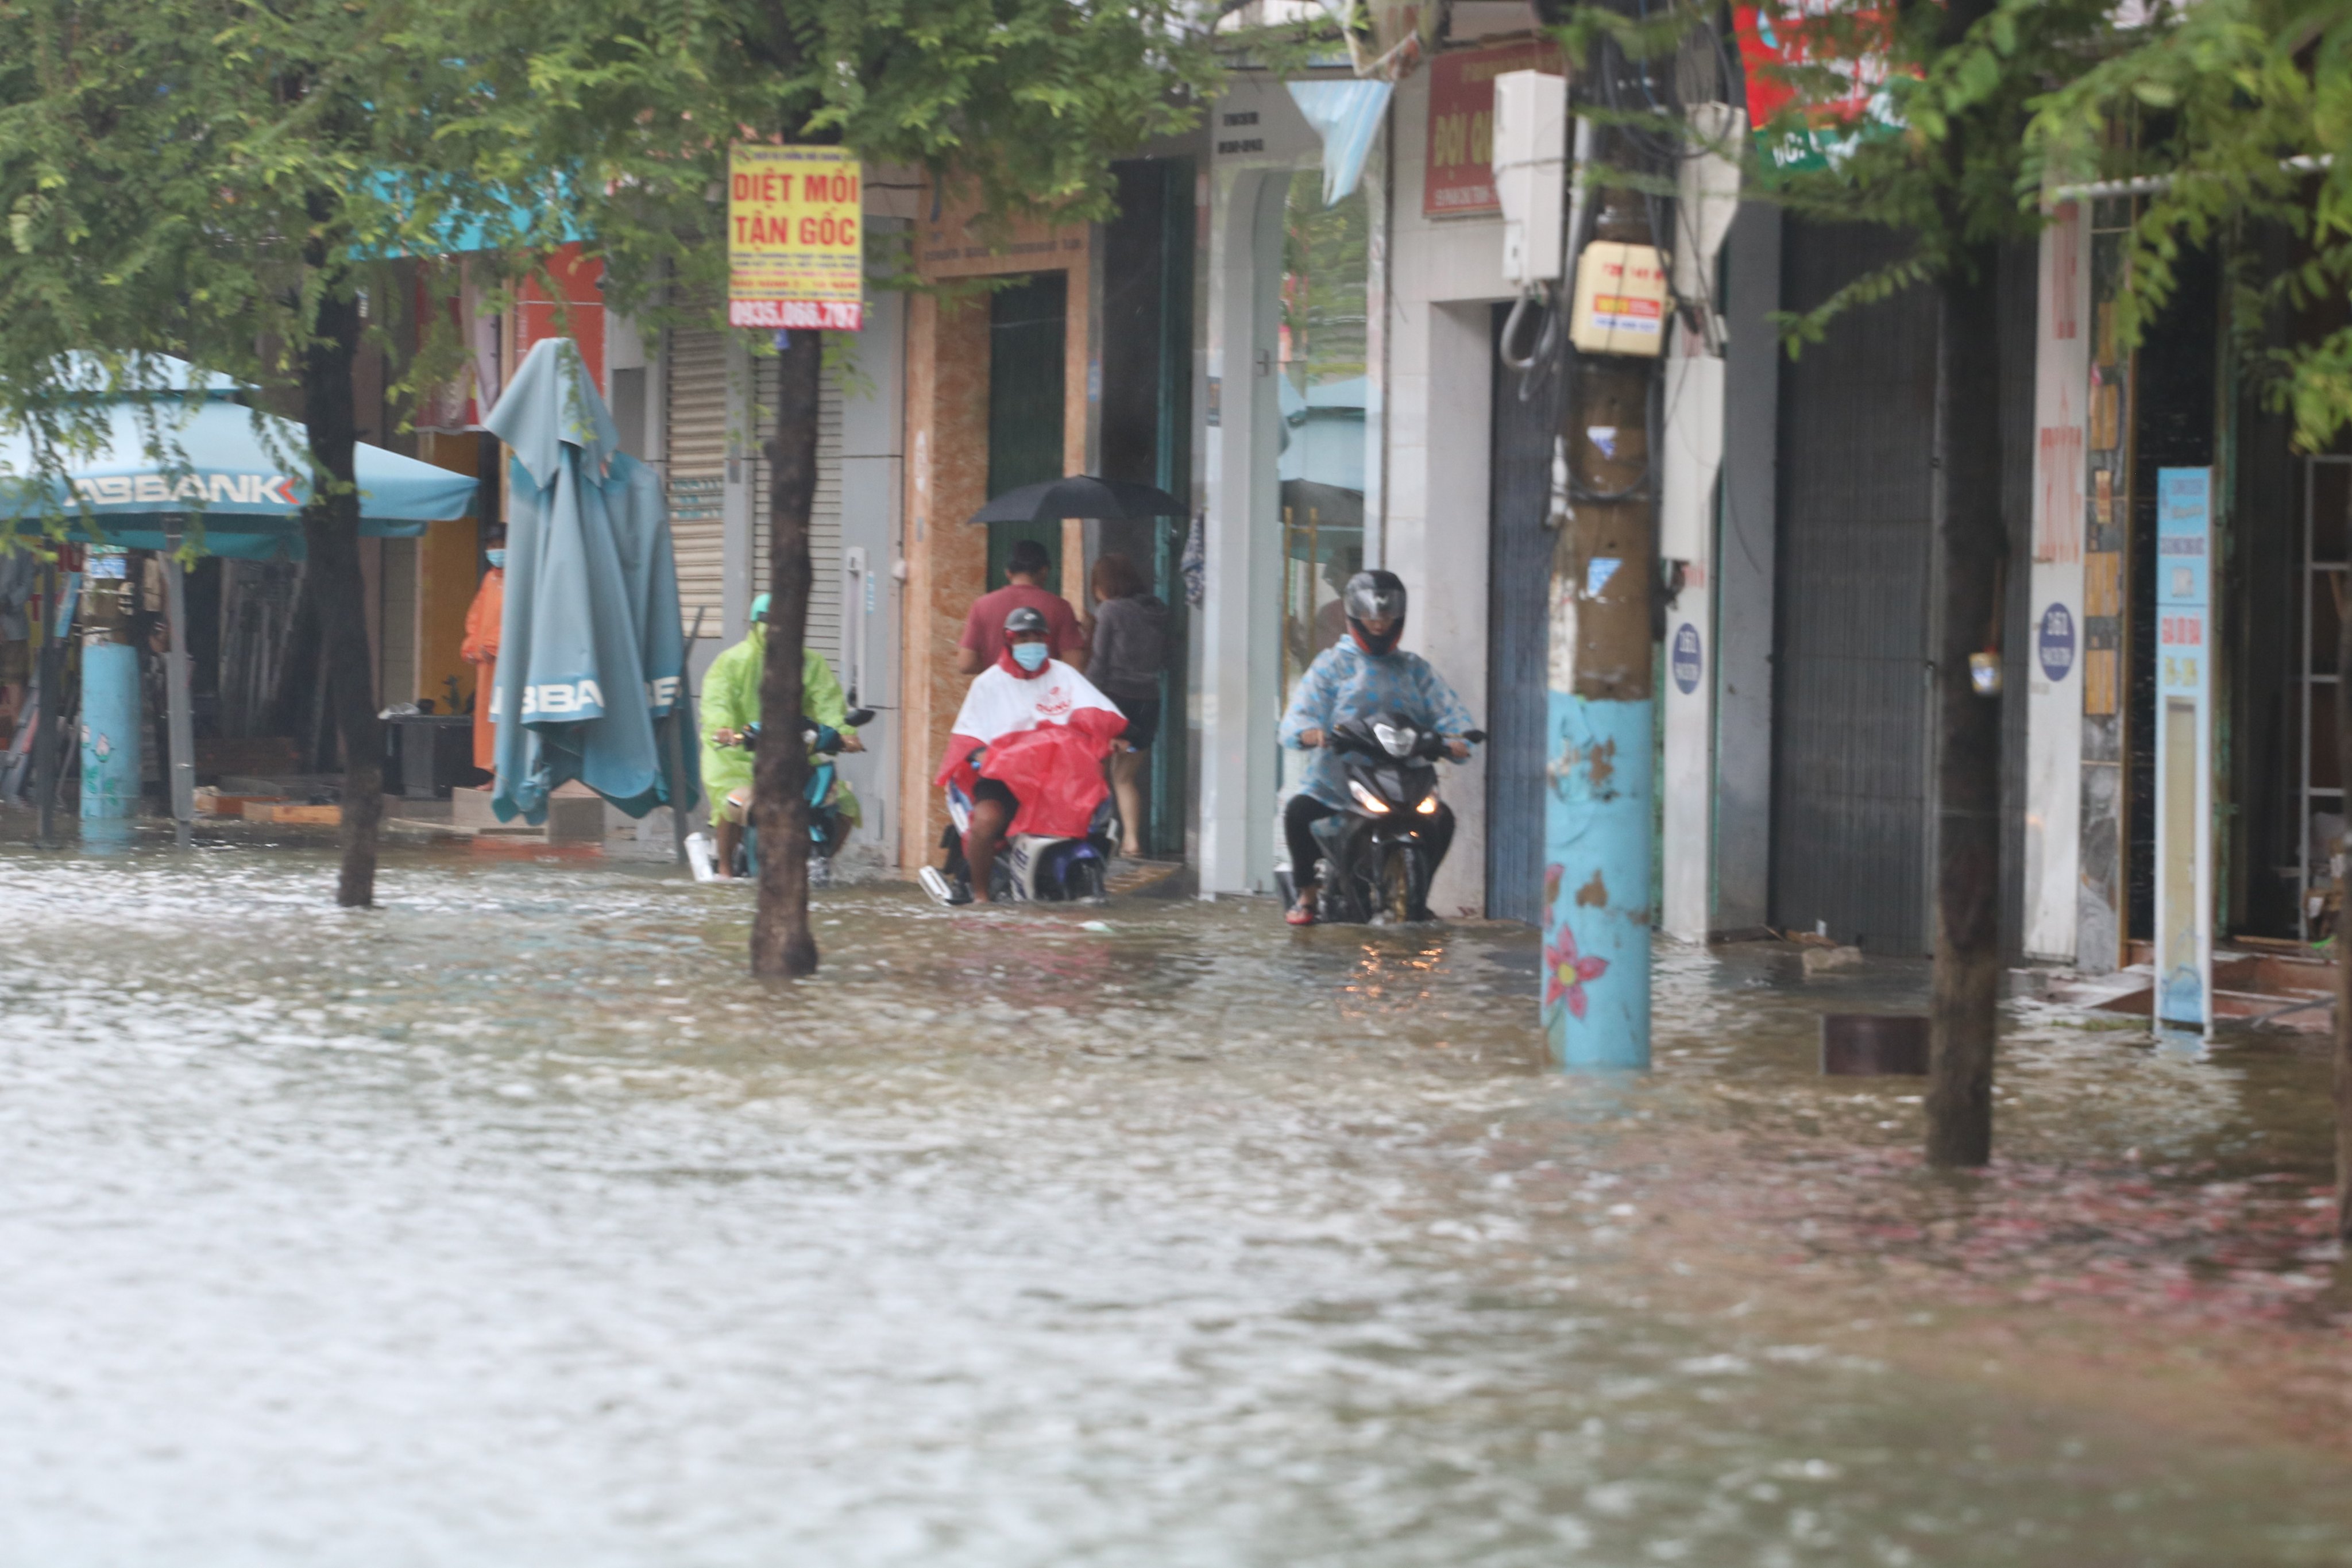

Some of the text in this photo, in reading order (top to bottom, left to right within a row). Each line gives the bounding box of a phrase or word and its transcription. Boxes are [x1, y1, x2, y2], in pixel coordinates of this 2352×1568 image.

[733, 164, 858, 208] DIỆT MỐI
[735, 206, 855, 252] TẬN GỐC
[63, 473, 300, 507] ABBANK
